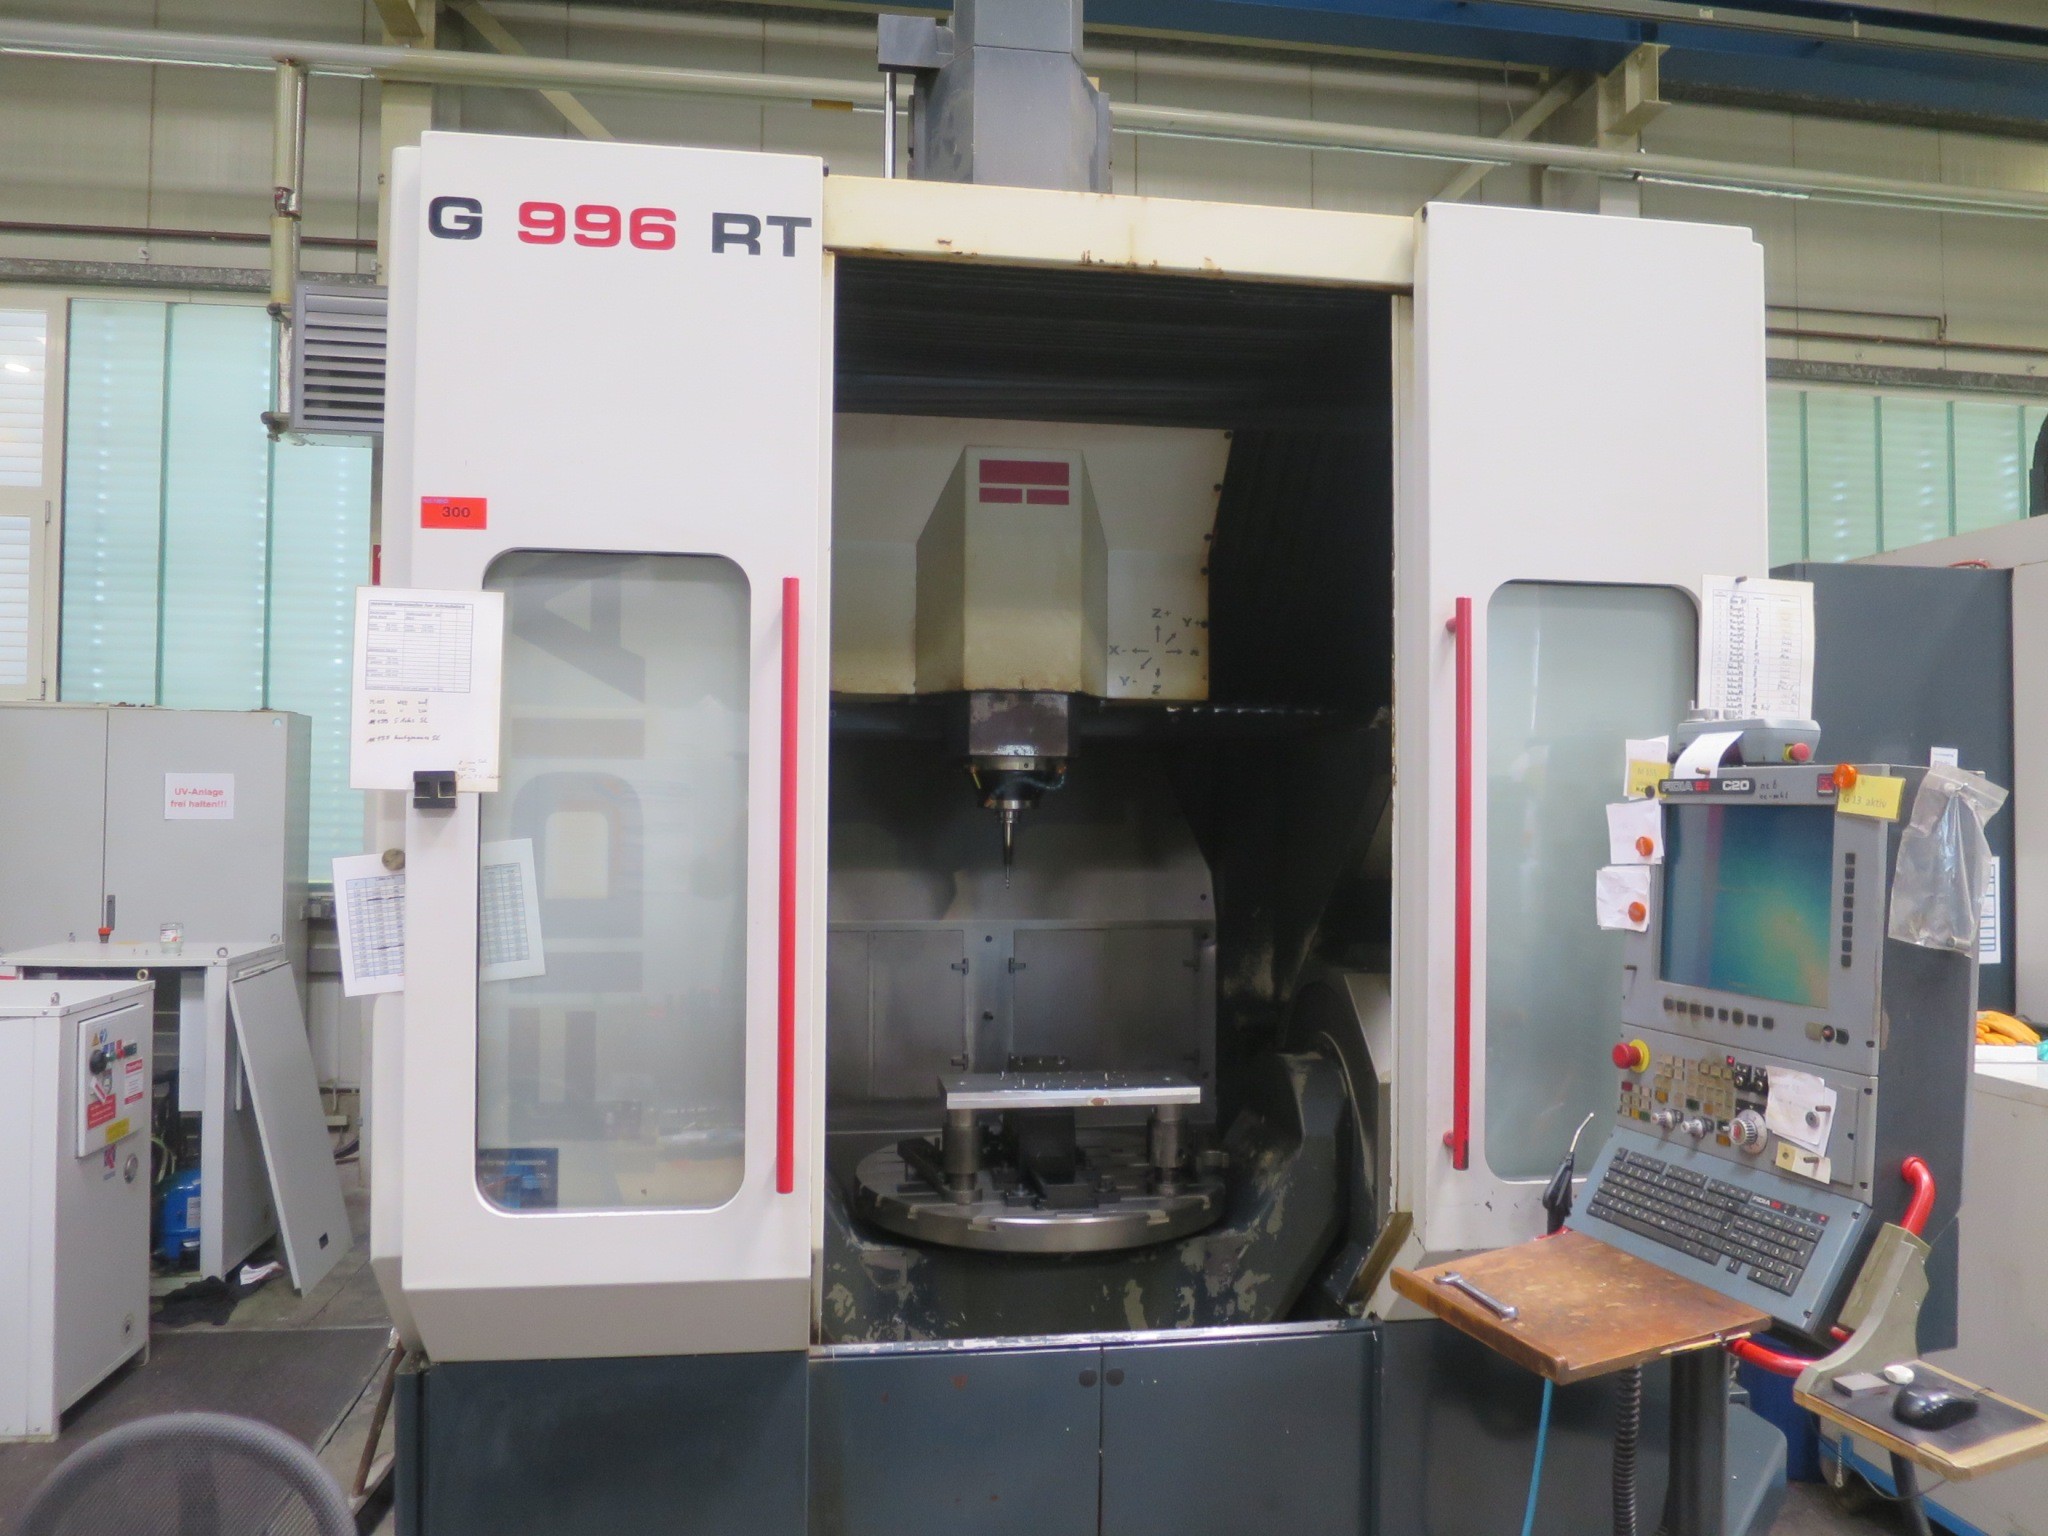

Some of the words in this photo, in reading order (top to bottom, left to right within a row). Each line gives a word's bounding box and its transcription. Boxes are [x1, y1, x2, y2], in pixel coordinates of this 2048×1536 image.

[428, 196, 483, 240] G
[517, 201, 677, 251] 996
[711, 211, 813, 257] RT
[442, 506, 471, 518] 300
[1722, 780, 1750, 791] C20
[174, 787, 224, 797] UV-Anlage
[170, 799, 186, 808] frei
[188, 800, 227, 808] halten!!!
[1852, 796, 1862, 805] 13
[1865, 797, 1888, 809] aktiv
